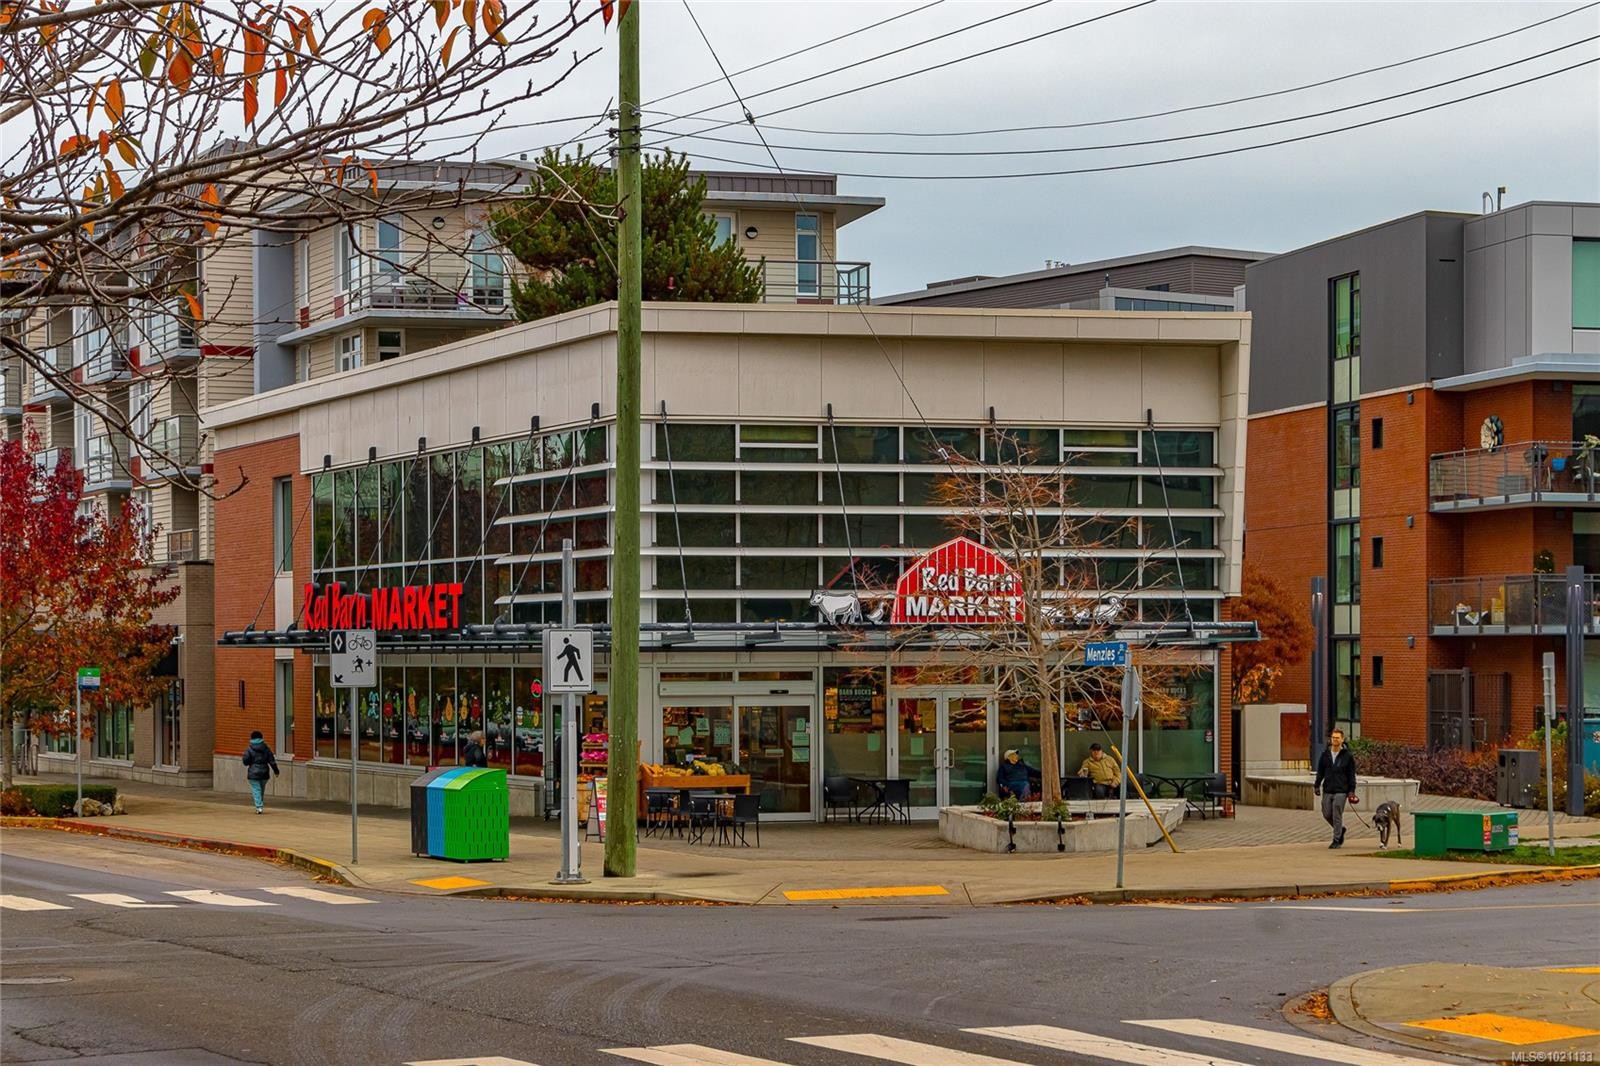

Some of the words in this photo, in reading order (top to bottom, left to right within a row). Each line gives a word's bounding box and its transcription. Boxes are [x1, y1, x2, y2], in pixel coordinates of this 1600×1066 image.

[922, 567, 960, 592] Red
[964, 567, 1013, 592] Barn
[304, 582, 329, 630] Red
[332, 581, 367, 630] Barn
[371, 582, 464, 630] MARKET
[906, 595, 1021, 617] MARKET
[1086, 647, 1116, 662] Menzies
